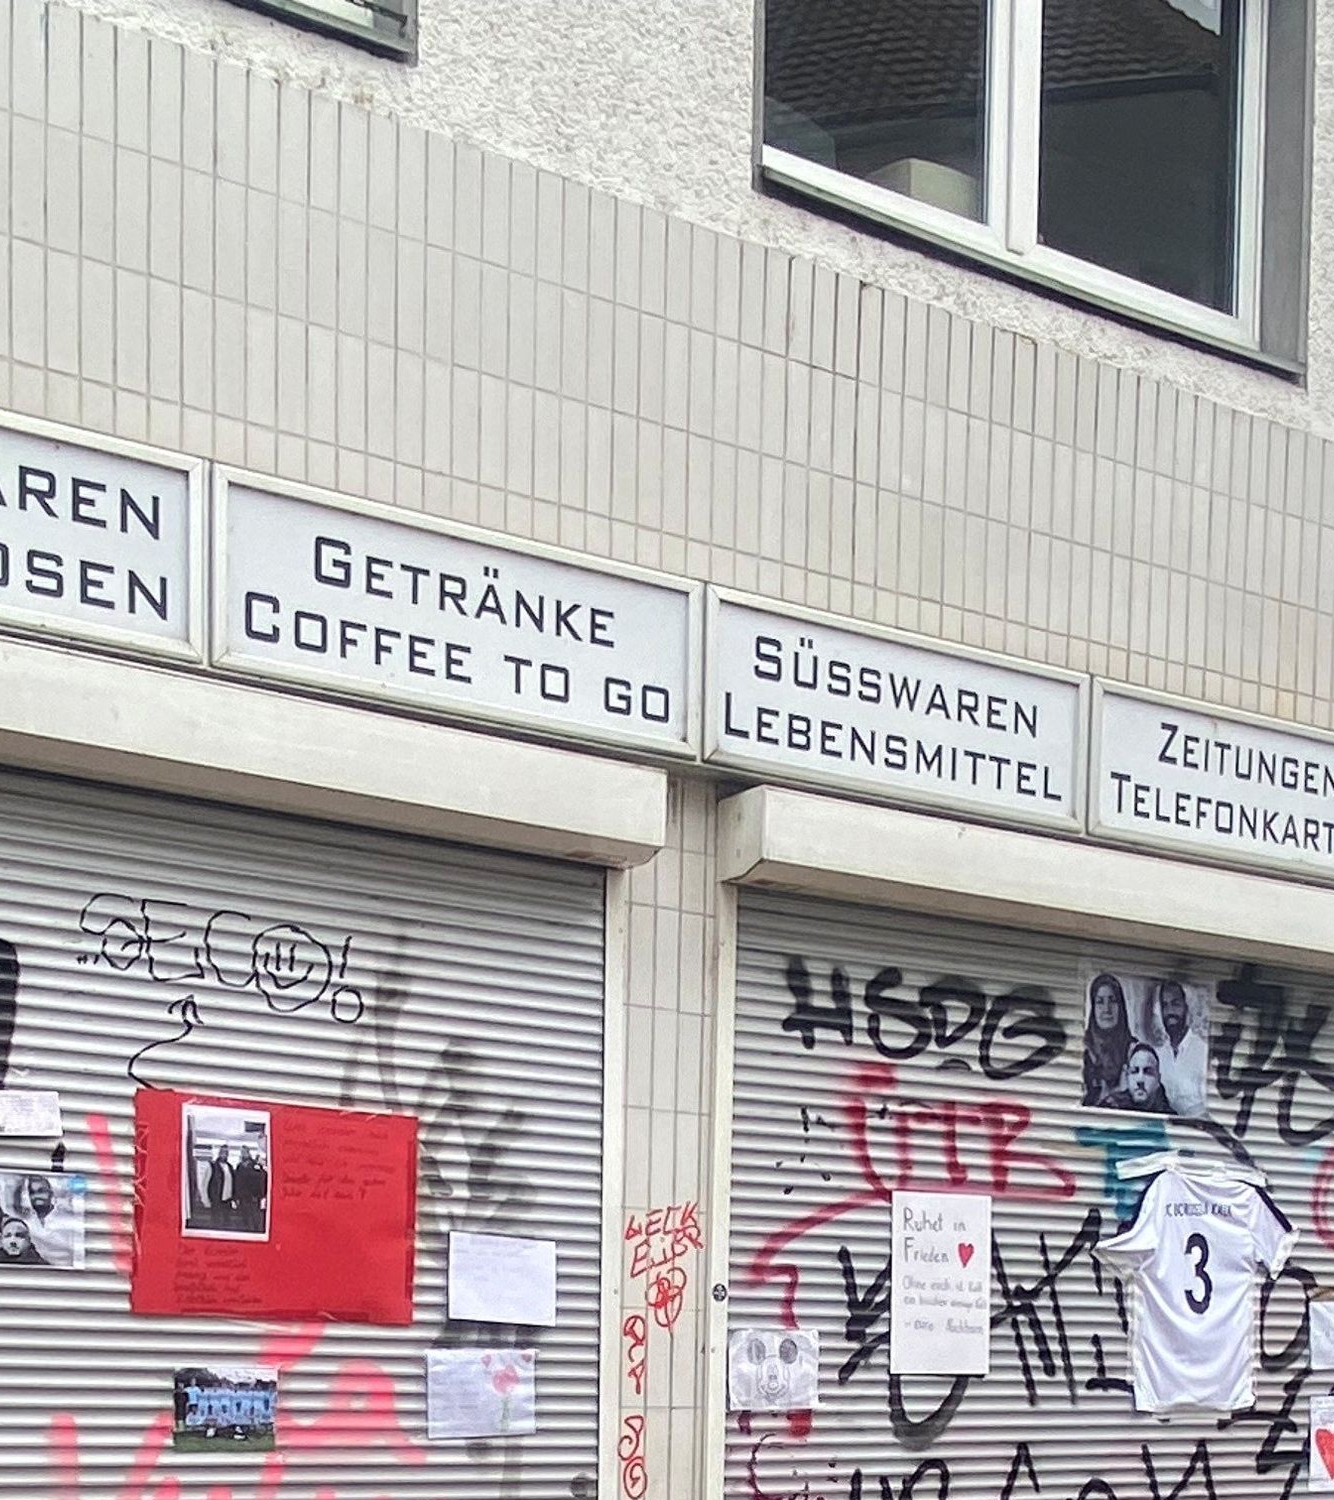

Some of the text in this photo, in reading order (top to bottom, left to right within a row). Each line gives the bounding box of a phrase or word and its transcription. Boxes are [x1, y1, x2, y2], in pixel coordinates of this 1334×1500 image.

[314, 536, 615, 649] GETRÄNKE
[244, 590, 669, 723] COFFEE TO GO
[754, 635, 1038, 739] SÜSSWAREN
[724, 691, 1062, 802] LEBENSMITTEL
[903, 1206, 966, 1232] Ruhet in
[904, 1236, 949, 1263] Frieden
[1184, 1233, 1213, 1314] 3
